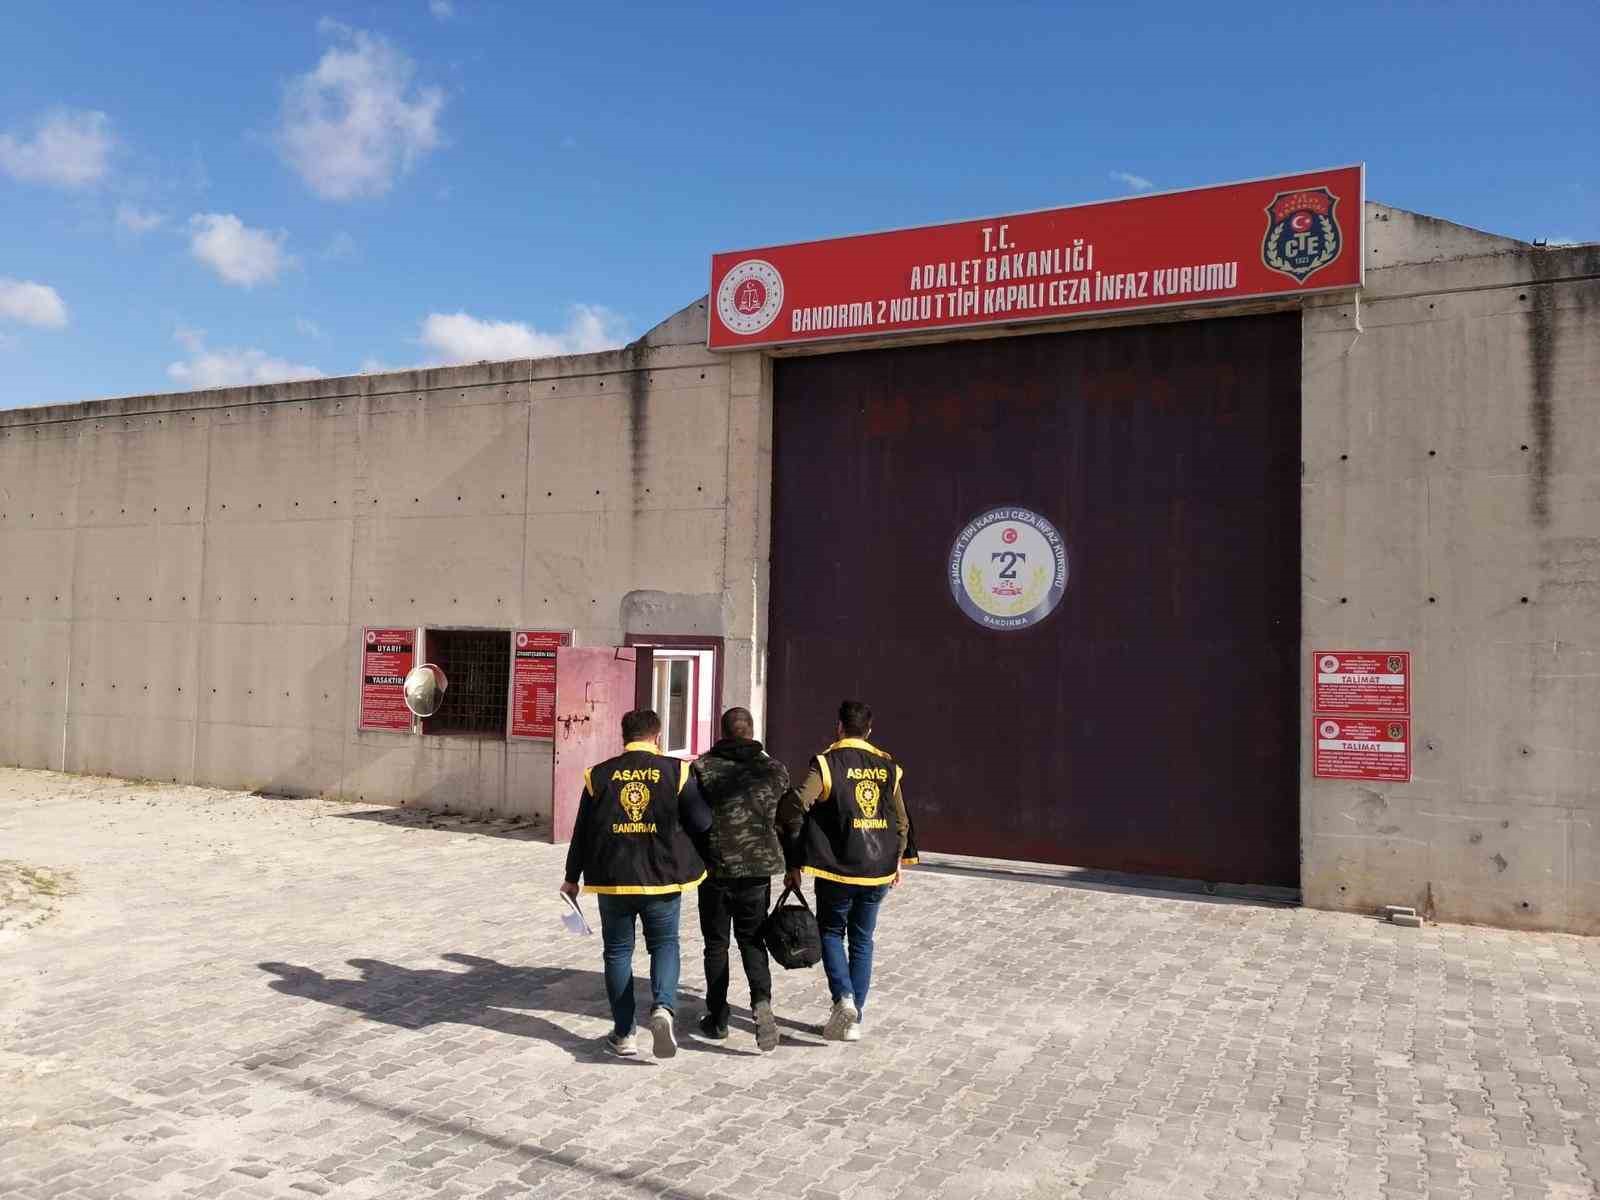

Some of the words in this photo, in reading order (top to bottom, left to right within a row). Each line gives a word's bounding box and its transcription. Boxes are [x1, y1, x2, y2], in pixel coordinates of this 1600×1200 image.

[982, 224, 1016, 253] T.C.
[1285, 232, 1319, 257] CTE
[910, 259, 982, 291] ADALET
[986, 239, 1094, 282] BAKANLIĞI
[791, 302, 873, 333] BANDIRMA
[876, 301, 887, 325] 2
[890, 297, 932, 322] NOLU
[934, 295, 945, 319] T
[947, 287, 980, 317] TİPİ
[983, 281, 1043, 314] KAPALI
[1049, 277, 1091, 307] CEZA
[1095, 271, 1149, 302] İNFAZ
[1153, 261, 1239, 296] KURUMU
